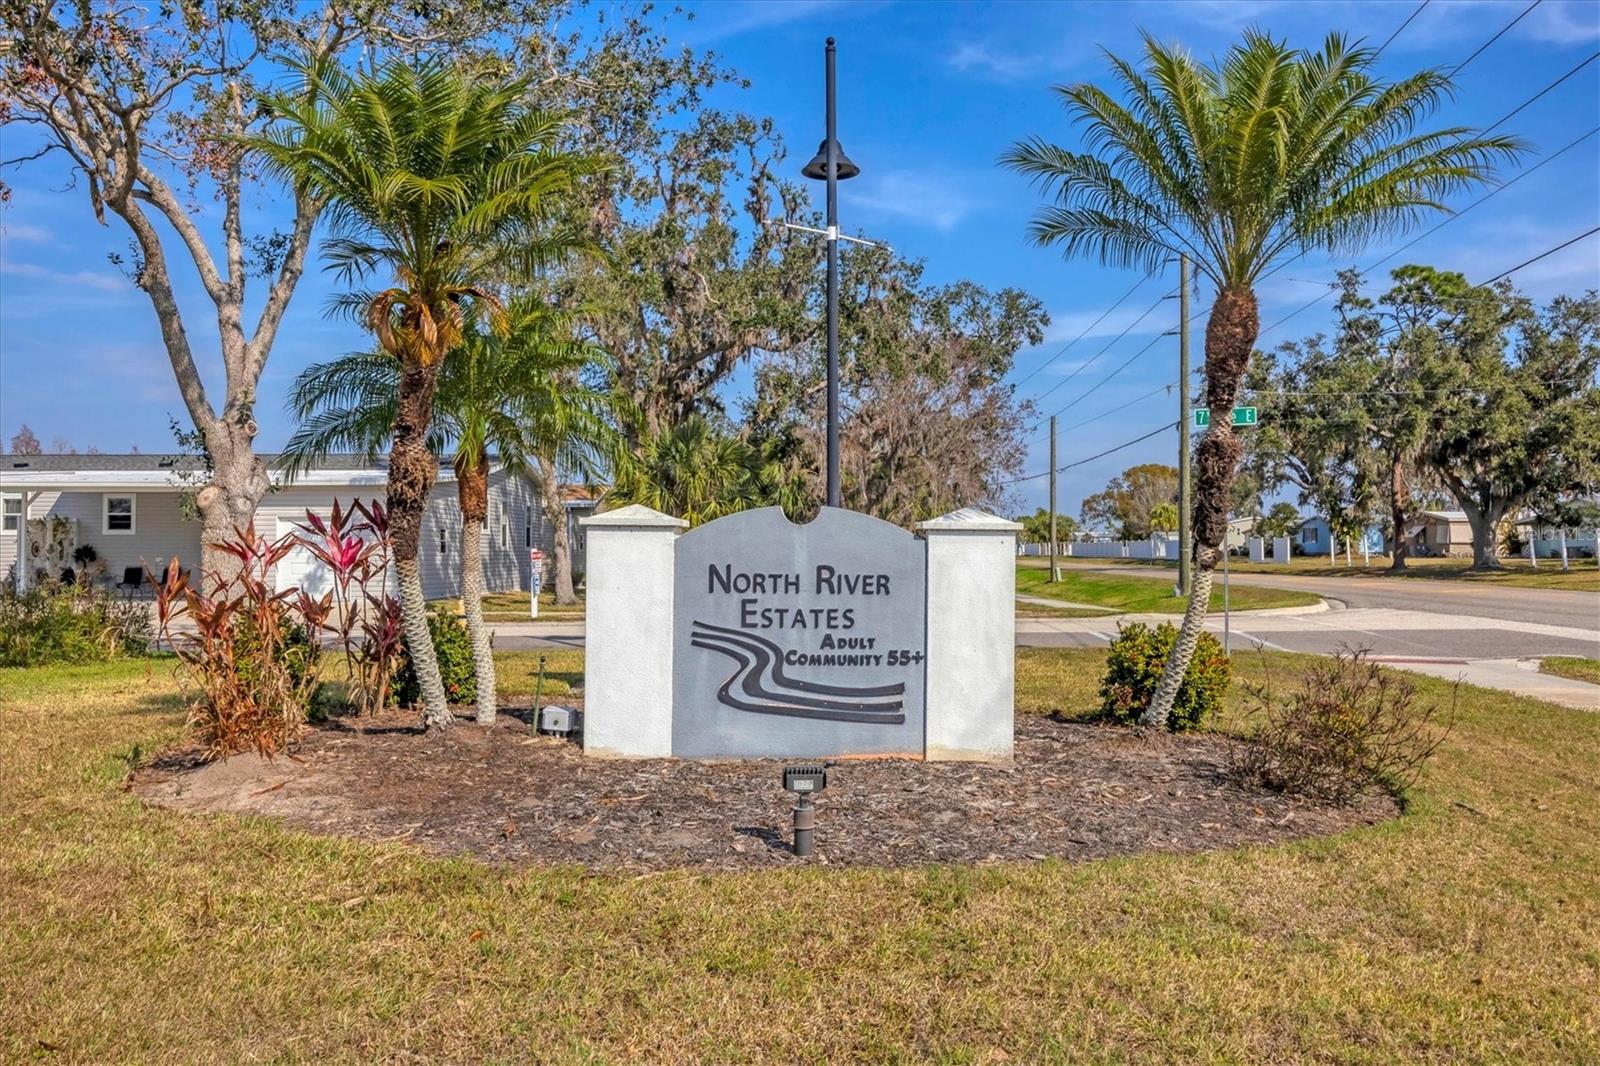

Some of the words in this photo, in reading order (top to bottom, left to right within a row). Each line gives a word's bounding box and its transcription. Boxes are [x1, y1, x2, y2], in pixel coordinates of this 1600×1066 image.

[1246, 409, 1252, 423] E
[708, 563, 800, 594] NORTH
[816, 565, 891, 595] RIVER
[740, 598, 855, 630] ESTATES
[819, 633, 876, 650] ADULT
[784, 649, 883, 667] COMMUNITY
[886, 650, 925, 666] 55+
